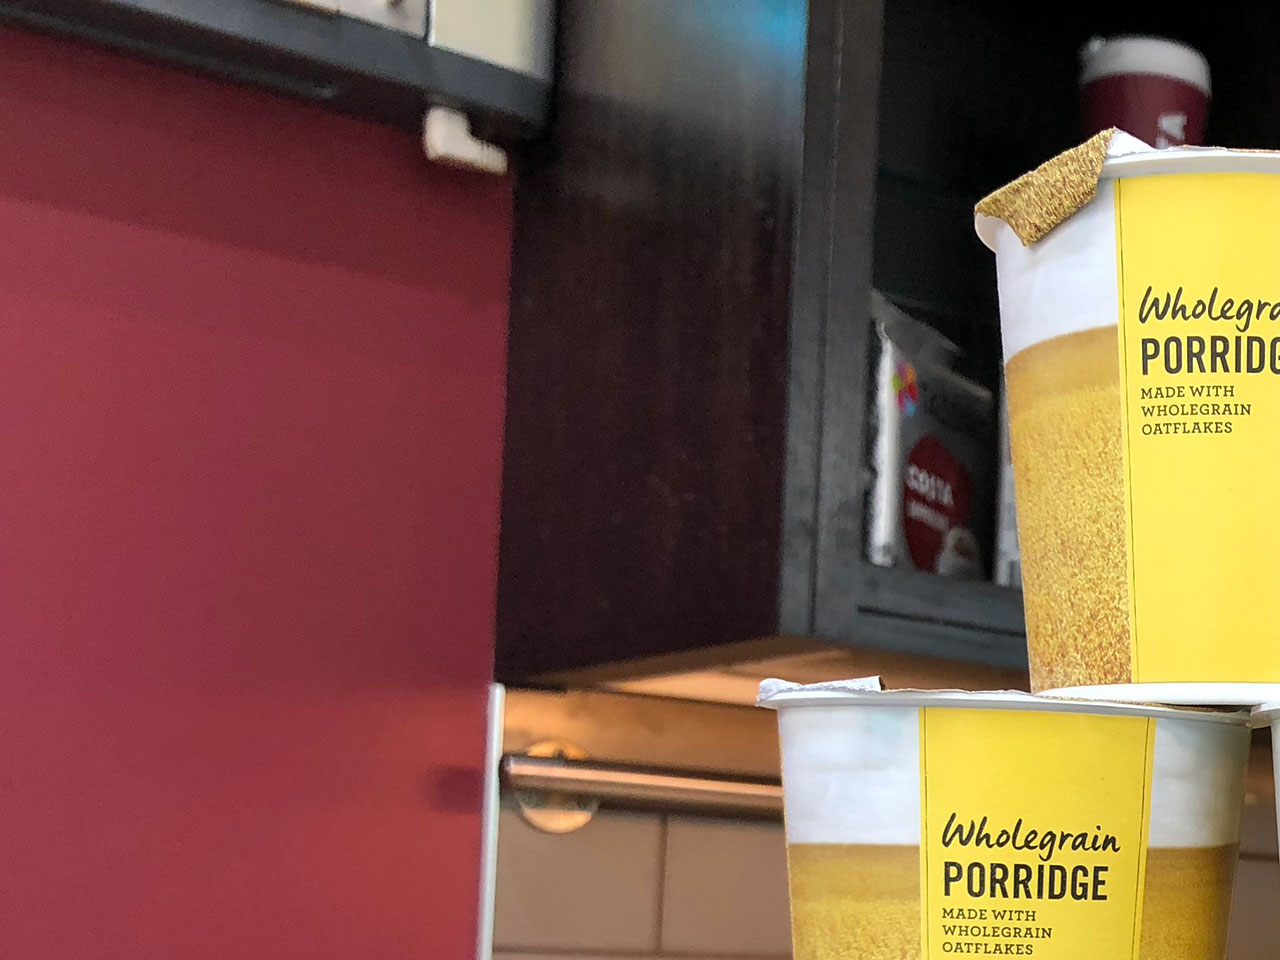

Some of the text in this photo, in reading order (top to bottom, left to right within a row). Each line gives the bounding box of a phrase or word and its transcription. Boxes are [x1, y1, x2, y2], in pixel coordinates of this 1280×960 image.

[1141, 385, 1235, 400] MADE WITH
[1141, 403, 1251, 417] WHOLEGRAIN
[1141, 421, 1233, 436] OATFLAKES
[941, 812, 1121, 862] Wholegrain
[944, 861, 1109, 901] PORRIDGE
[942, 907, 1036, 922] MADE WITH
[942, 924, 1053, 939] WHOLEGRAIN
[942, 941, 1033, 956] OATFLAKES
